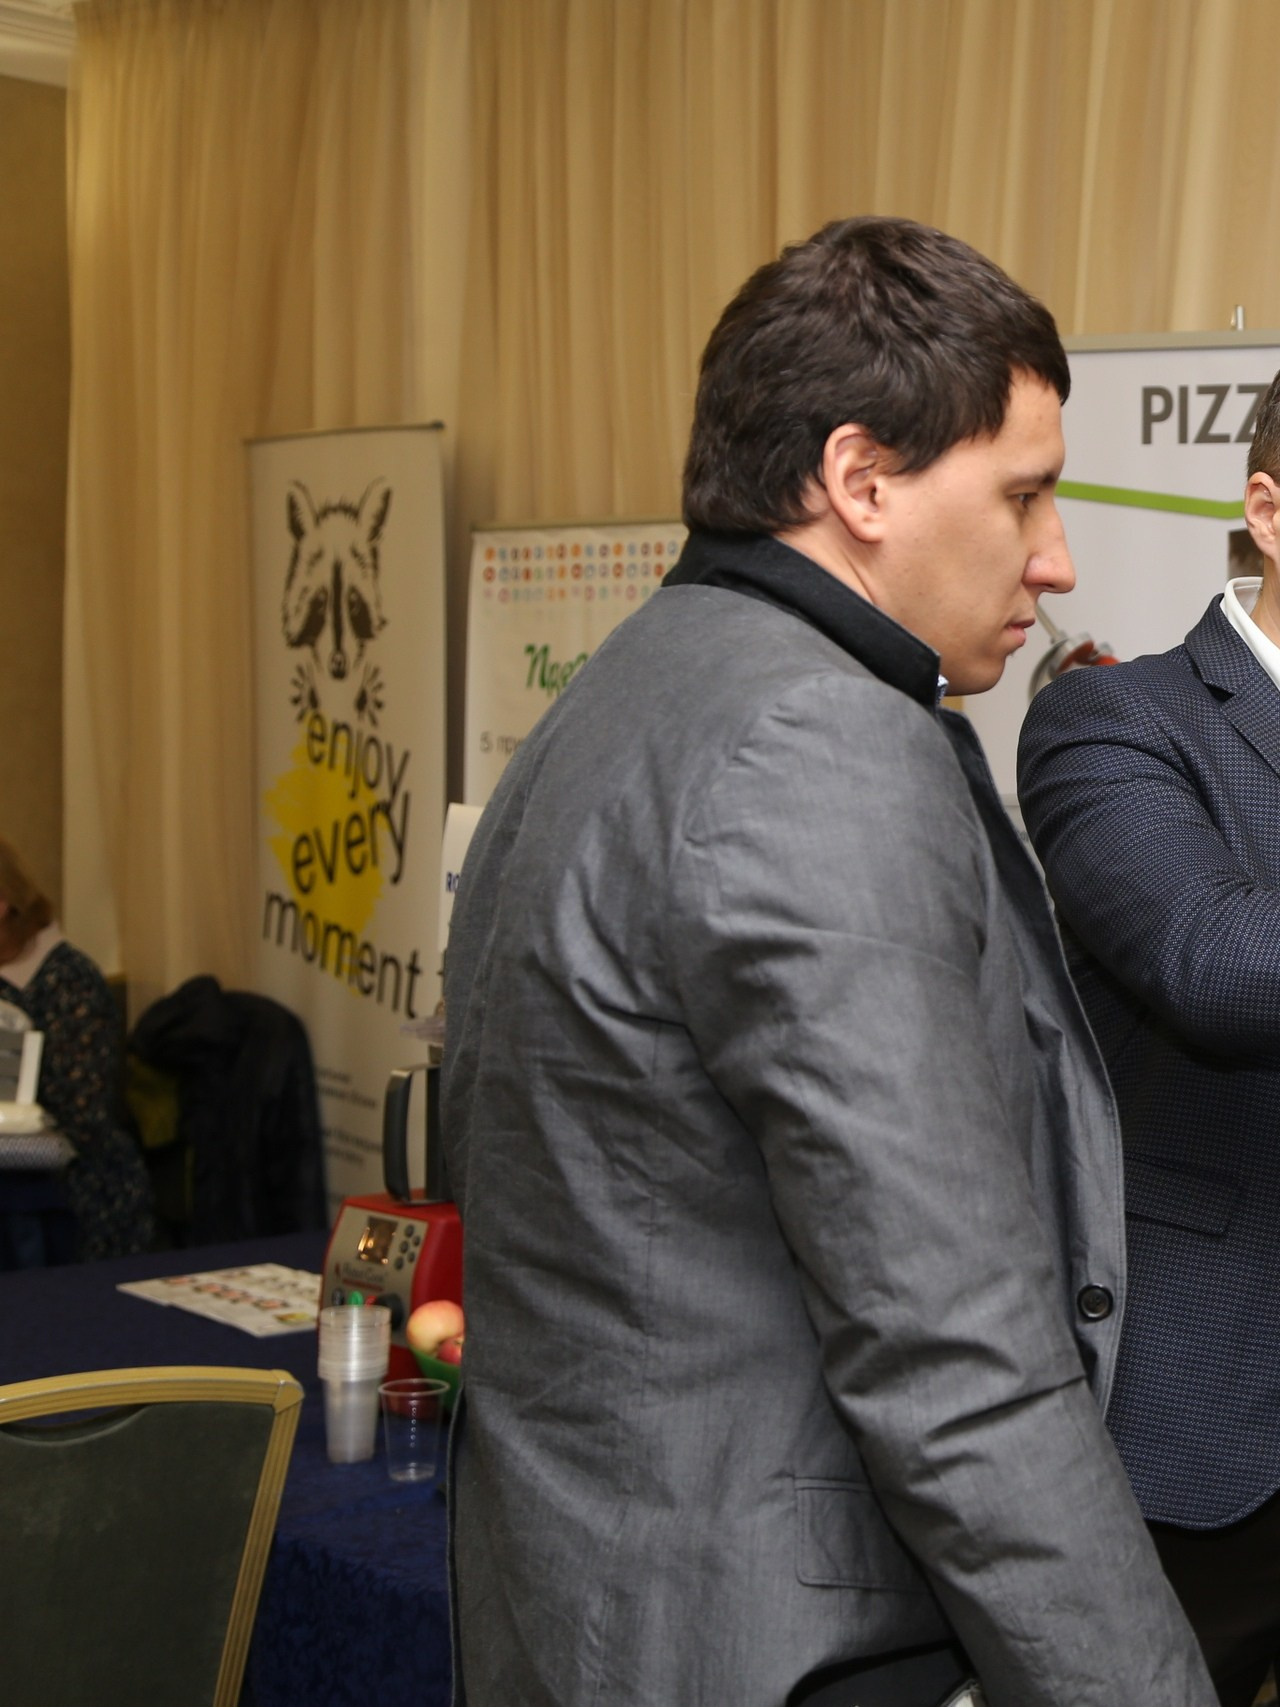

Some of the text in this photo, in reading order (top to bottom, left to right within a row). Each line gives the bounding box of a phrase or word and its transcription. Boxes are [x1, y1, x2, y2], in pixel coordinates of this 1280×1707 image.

[307, 710, 411, 806] enjoy
[292, 790, 411, 895] every
[262, 890, 423, 1019] moment
